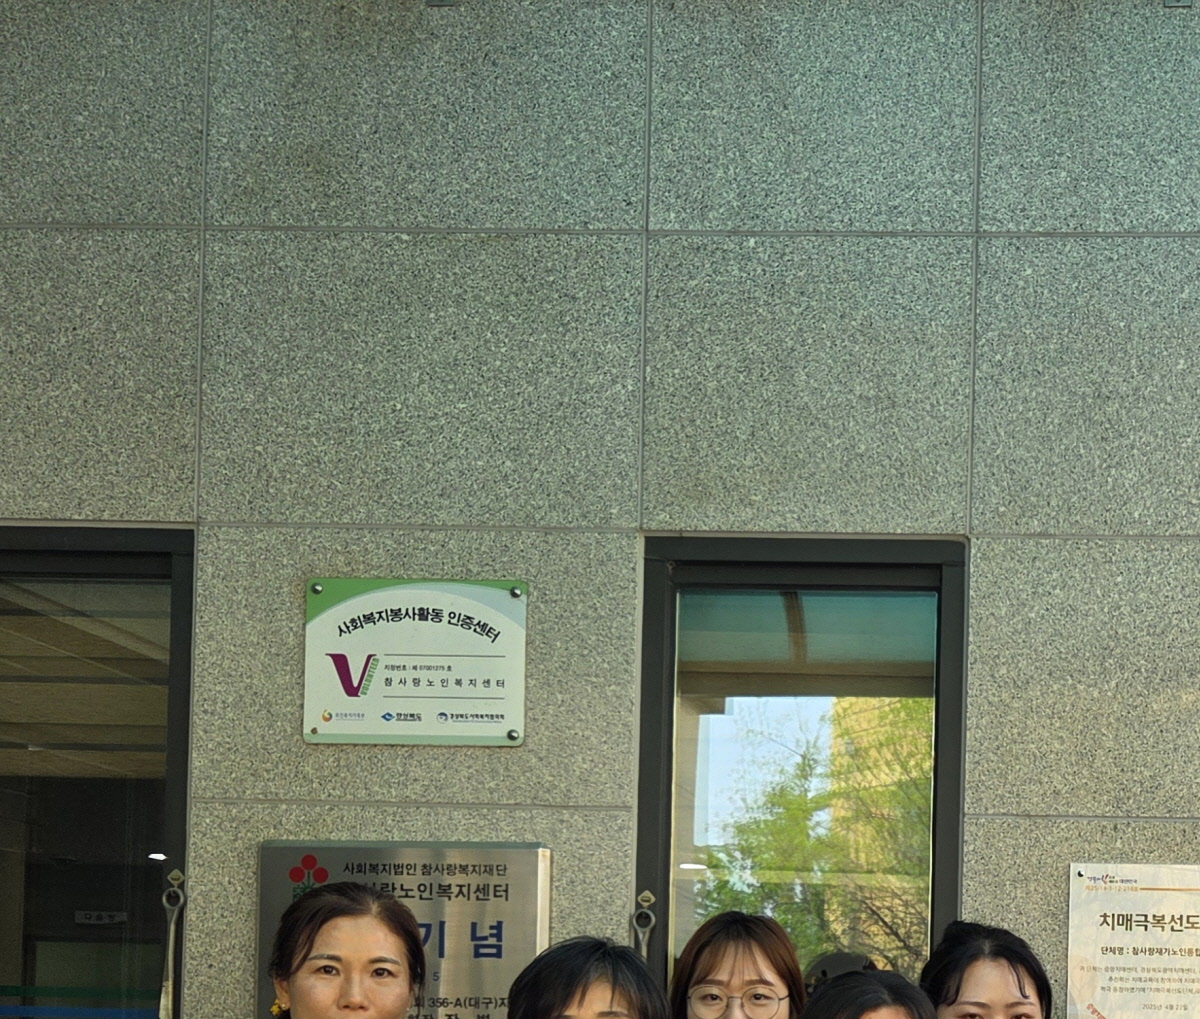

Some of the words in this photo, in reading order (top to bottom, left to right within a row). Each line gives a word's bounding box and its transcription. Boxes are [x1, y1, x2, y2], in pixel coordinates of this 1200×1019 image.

[337, 606, 444, 638] 사회복지봉사활동
[447, 610, 501, 643] 인증센터
[343, 862, 417, 876] 사회복지법인
[420, 862, 508, 877] 참사랑복지재단
[1101, 946, 1125, 955] 단체명
